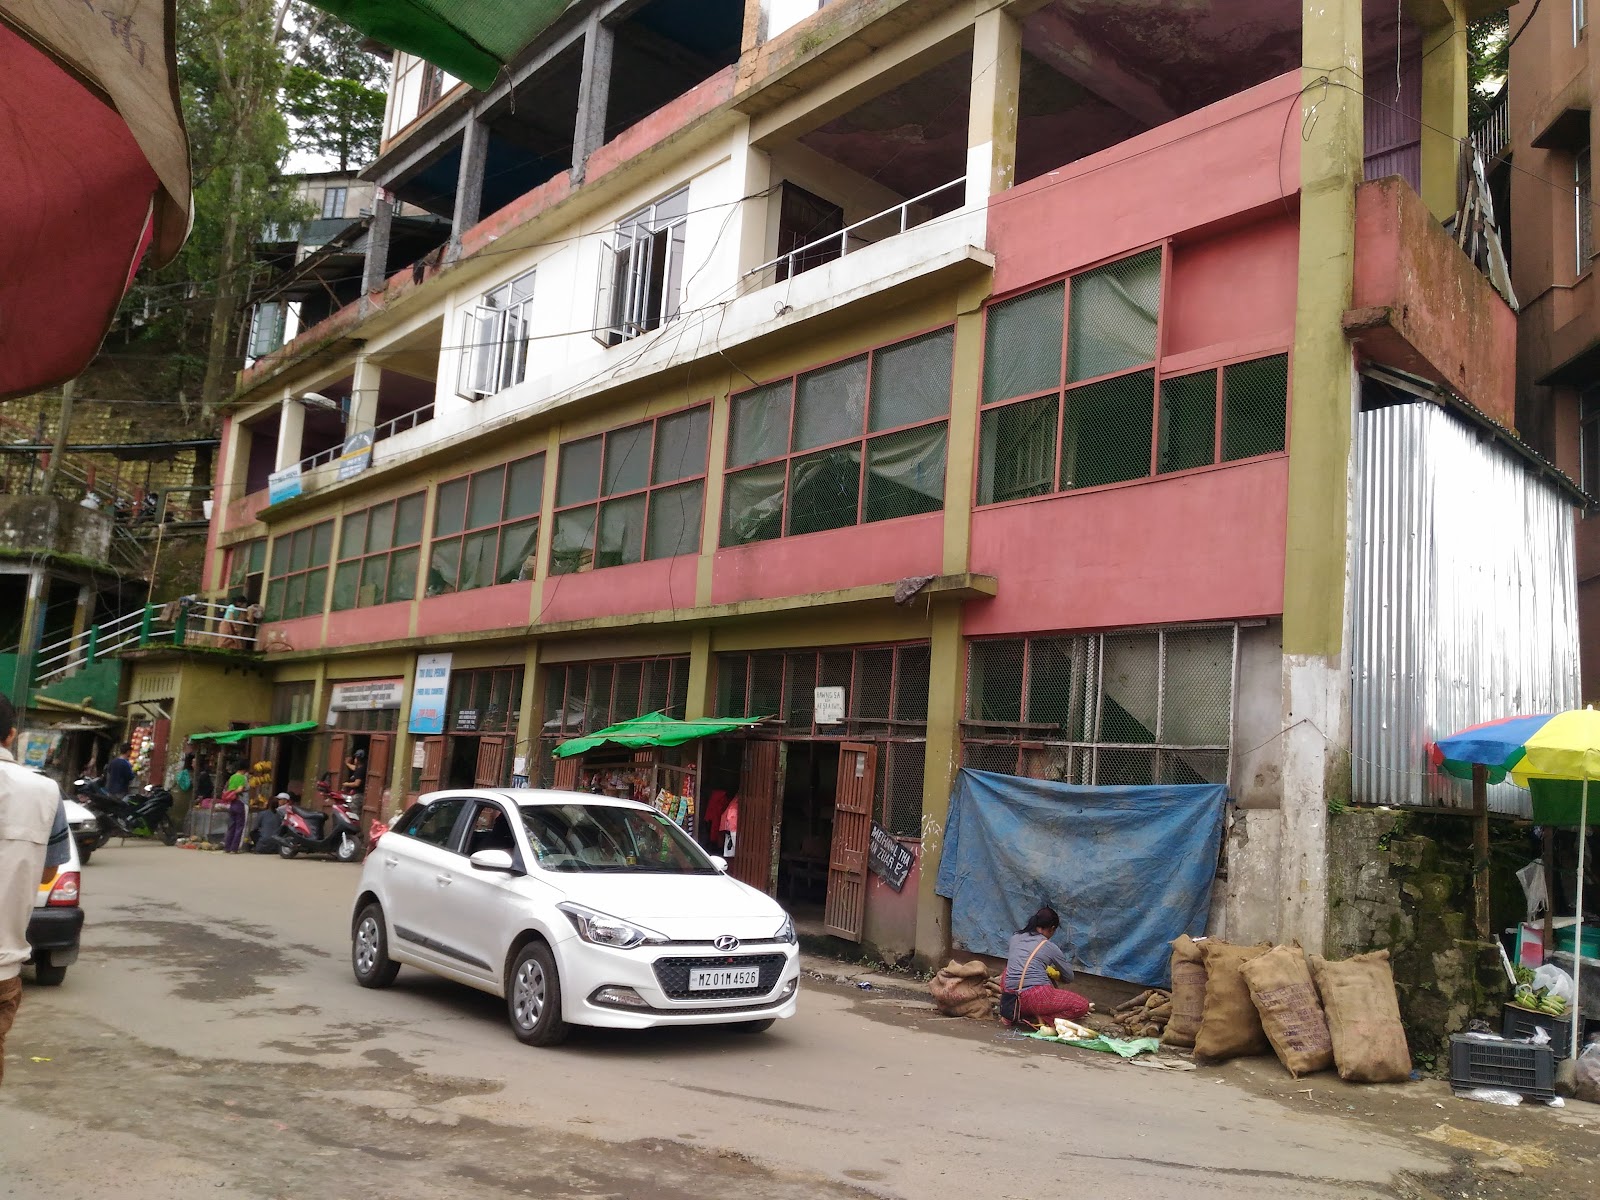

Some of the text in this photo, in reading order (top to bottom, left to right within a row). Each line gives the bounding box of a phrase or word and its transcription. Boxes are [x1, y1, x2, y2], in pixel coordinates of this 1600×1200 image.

[877, 847, 895, 869] ZUAR
[898, 848, 911, 867] THA
[698, 973, 711, 986] MZ
[733, 971, 756, 984] 4526
